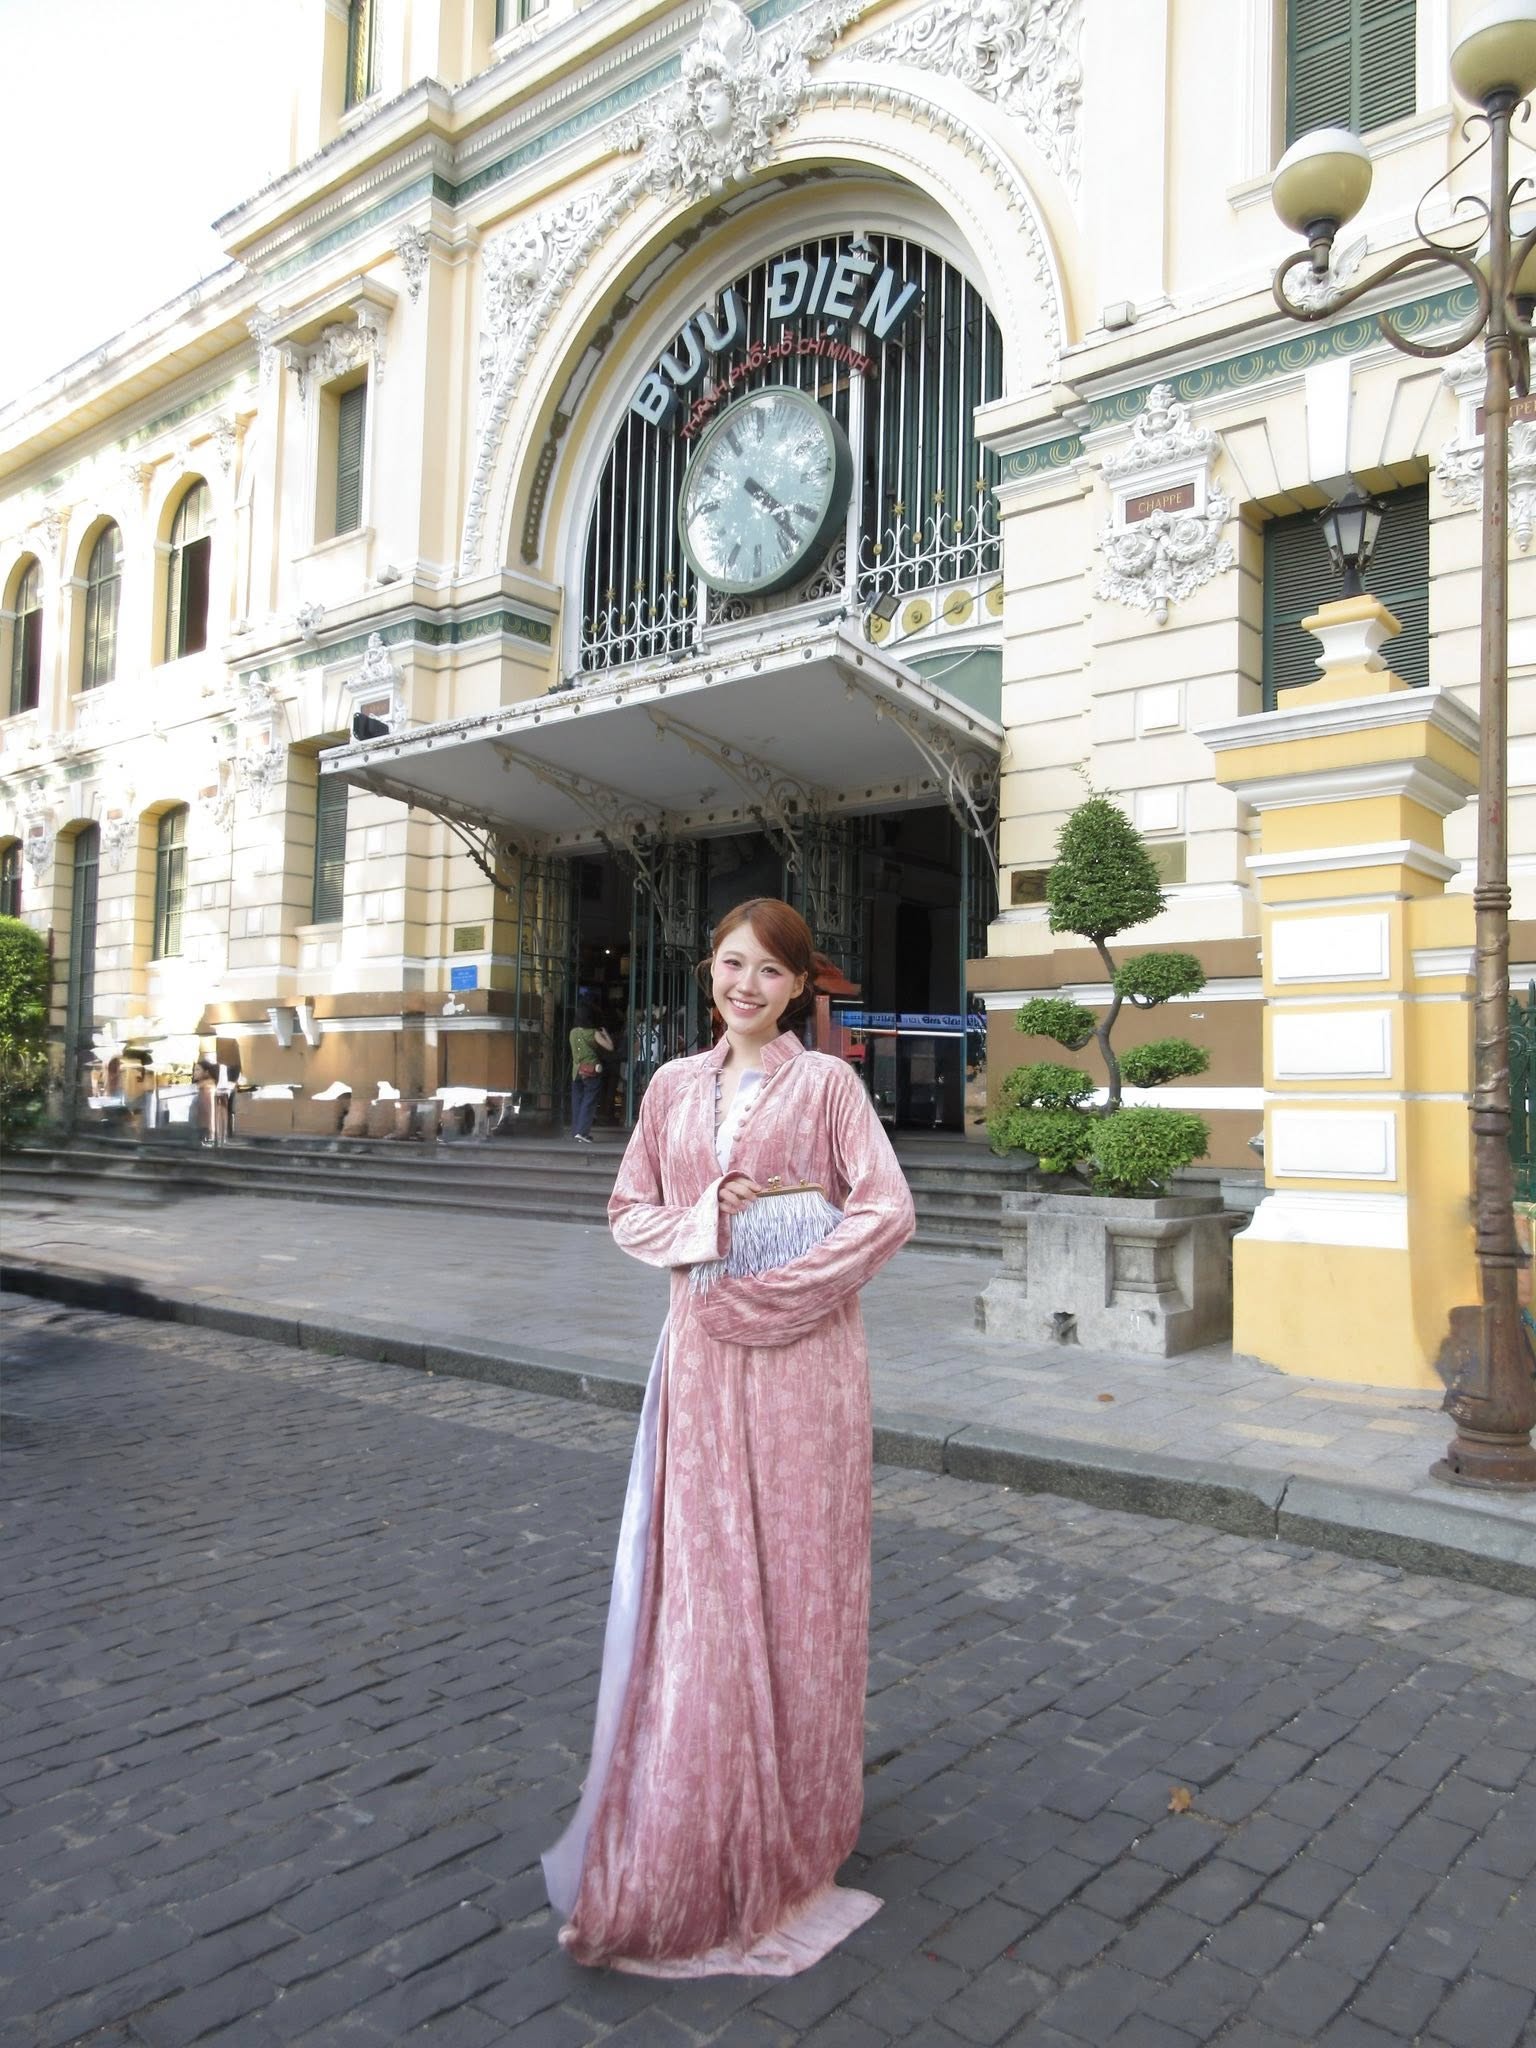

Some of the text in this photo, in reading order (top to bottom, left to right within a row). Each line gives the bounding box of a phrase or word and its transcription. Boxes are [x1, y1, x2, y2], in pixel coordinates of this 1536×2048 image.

[767, 239, 918, 340] ĐIỆN
[827, 341, 871, 373] MINH
[1138, 492, 1183, 514] CHAPPE
